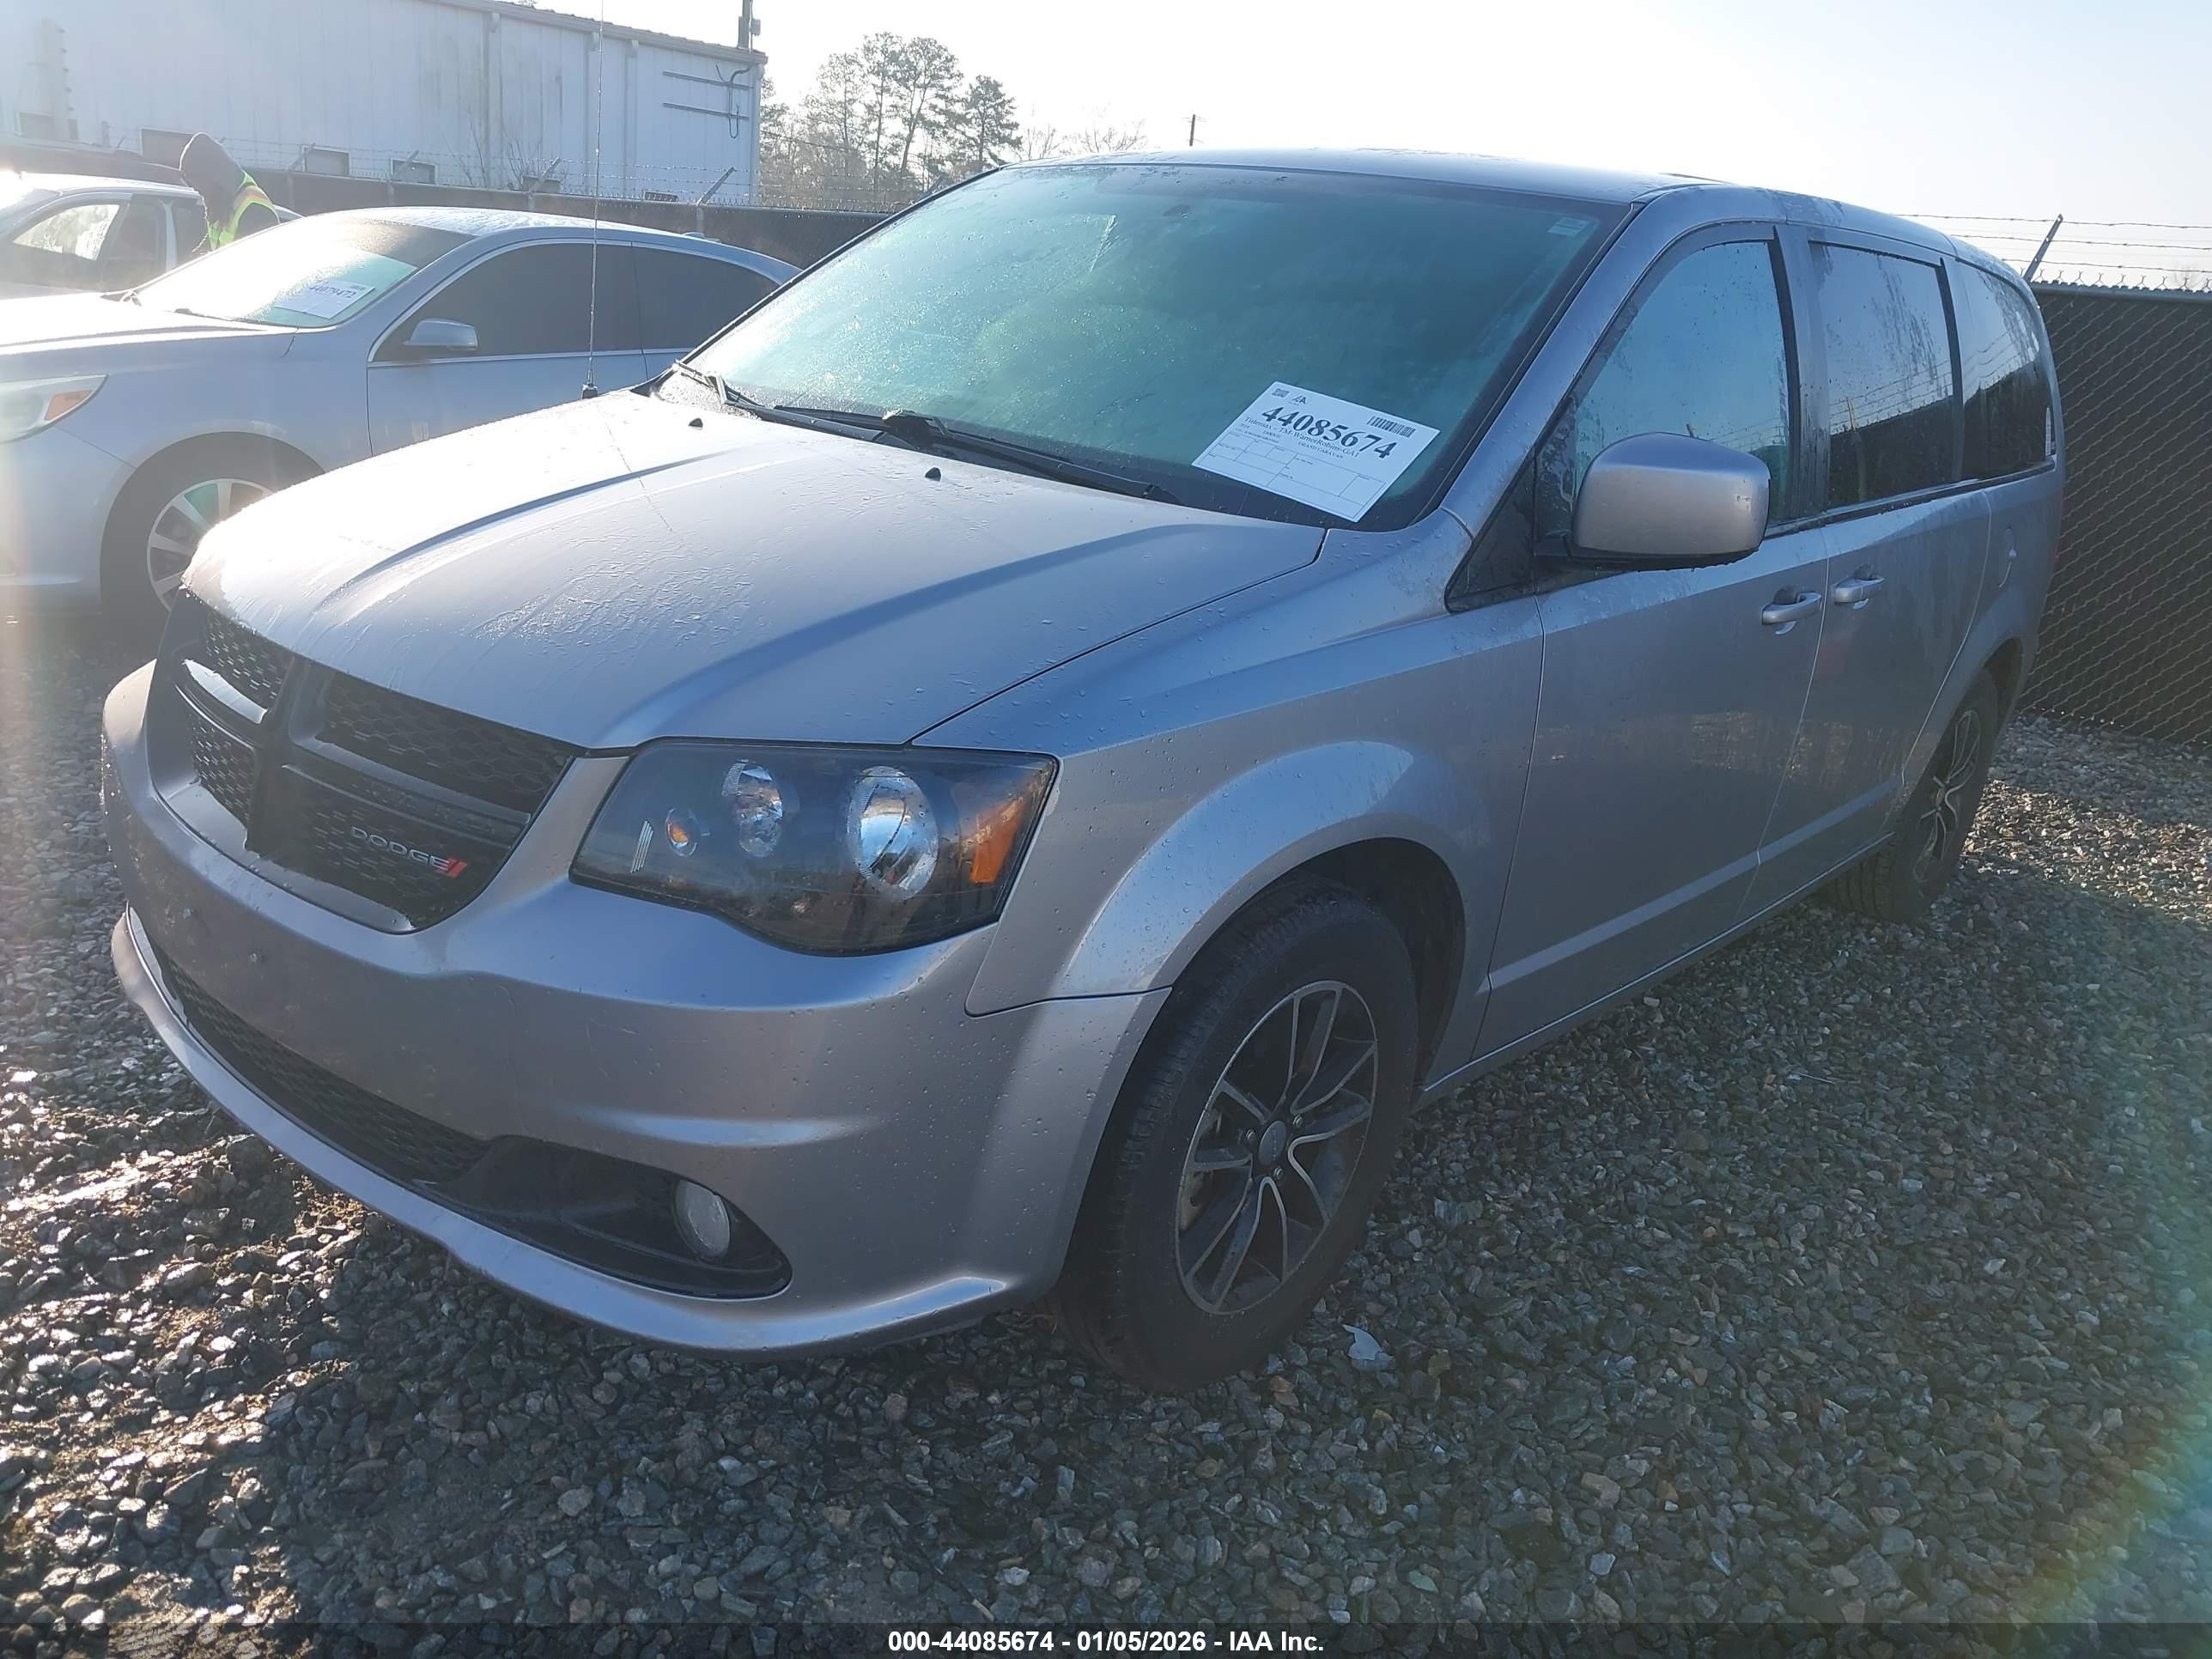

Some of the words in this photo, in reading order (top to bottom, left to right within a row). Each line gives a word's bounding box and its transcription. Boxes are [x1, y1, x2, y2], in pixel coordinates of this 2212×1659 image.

[1245, 417, 1273, 430] Titlemax
[1261, 407, 1397, 459] 44085674
[351, 826, 449, 872] DODGE
